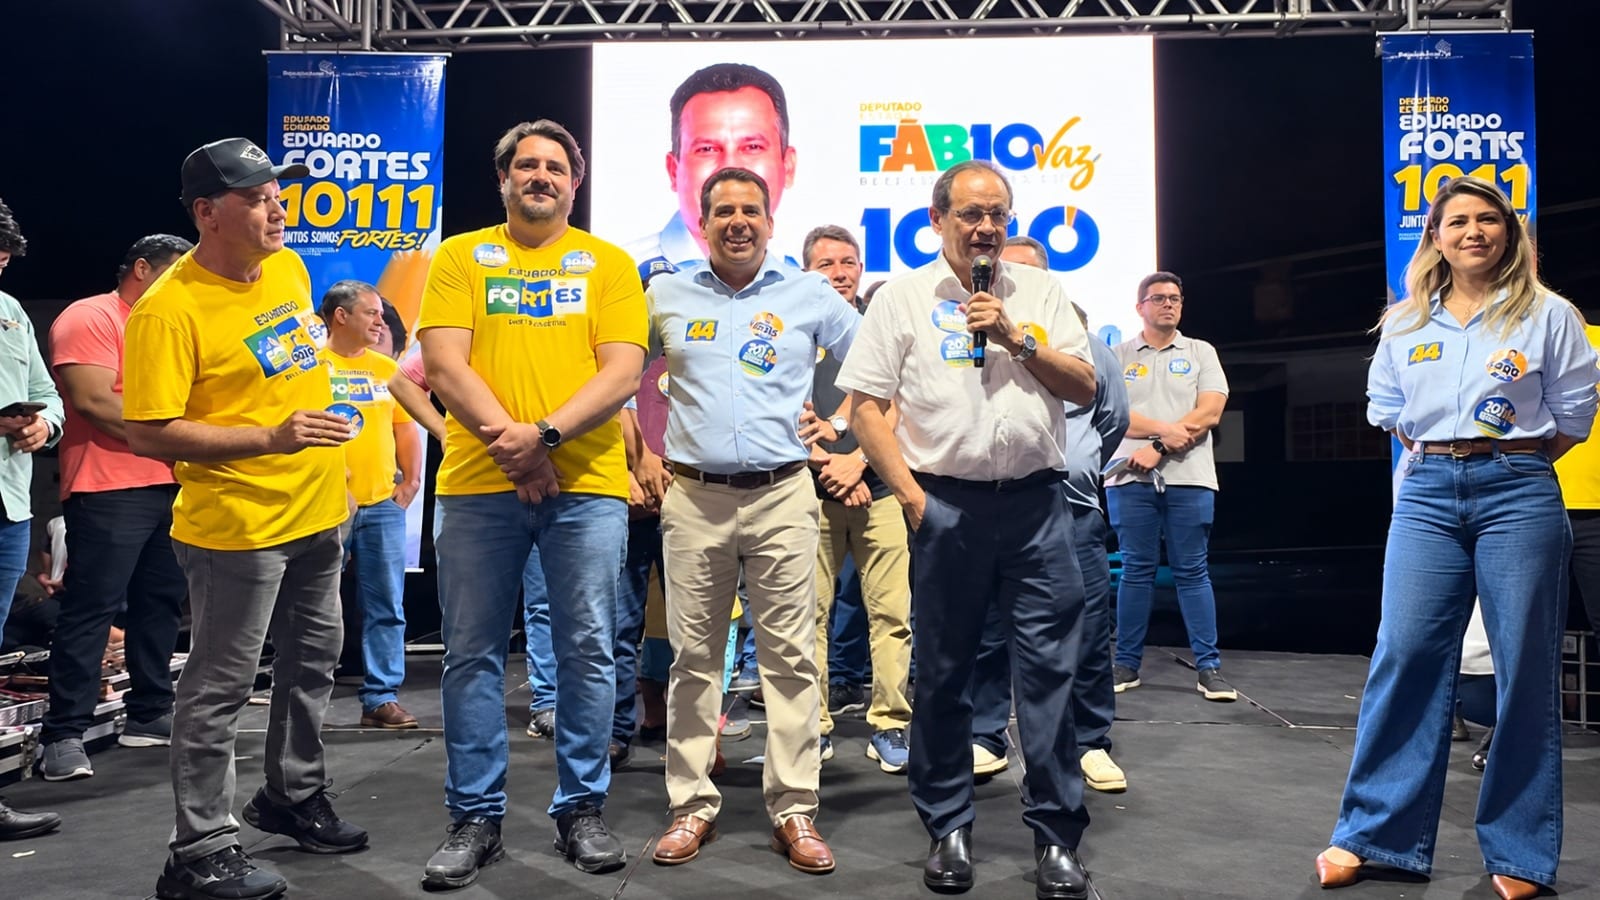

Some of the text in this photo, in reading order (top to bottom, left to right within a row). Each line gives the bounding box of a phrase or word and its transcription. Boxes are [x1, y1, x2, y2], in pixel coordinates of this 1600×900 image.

[859, 102, 922, 111] DEPUTADO
[1399, 113, 1502, 130] EDUARDO
[283, 132, 381, 149] EDUARDO
[1032, 116, 1098, 191] Vaz
[278, 181, 434, 230] 10111
[1399, 214, 1428, 228] JUNTO
[283, 229, 427, 250] UNTOS SOMOS FORTES!
[859, 205, 1100, 272] 100
[487, 286, 582, 308] FORTES
[687, 321, 715, 340] 44
[1409, 343, 1440, 363] 44
